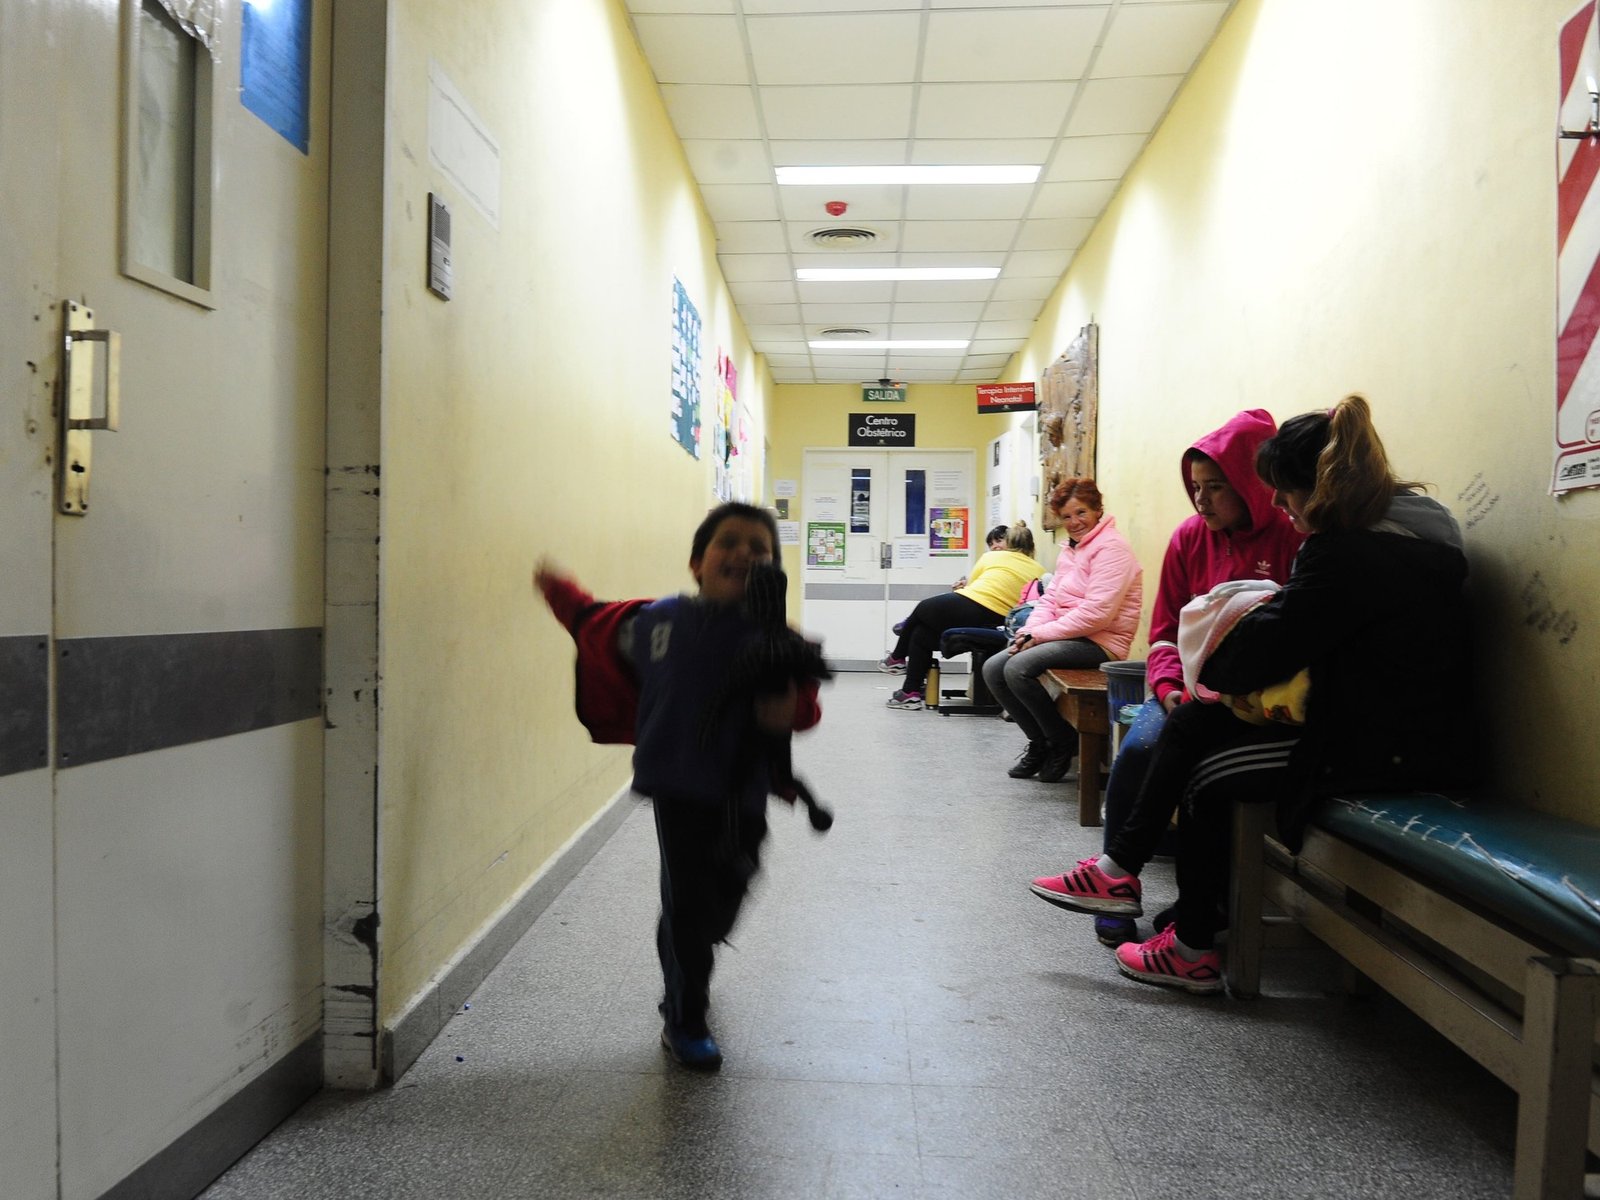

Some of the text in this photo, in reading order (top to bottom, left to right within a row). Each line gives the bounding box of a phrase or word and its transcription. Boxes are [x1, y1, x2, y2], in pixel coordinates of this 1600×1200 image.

[868, 390, 900, 400] SALIDA
[866, 415, 898, 425] Centro
[857, 426, 906, 437] Obstétrico
